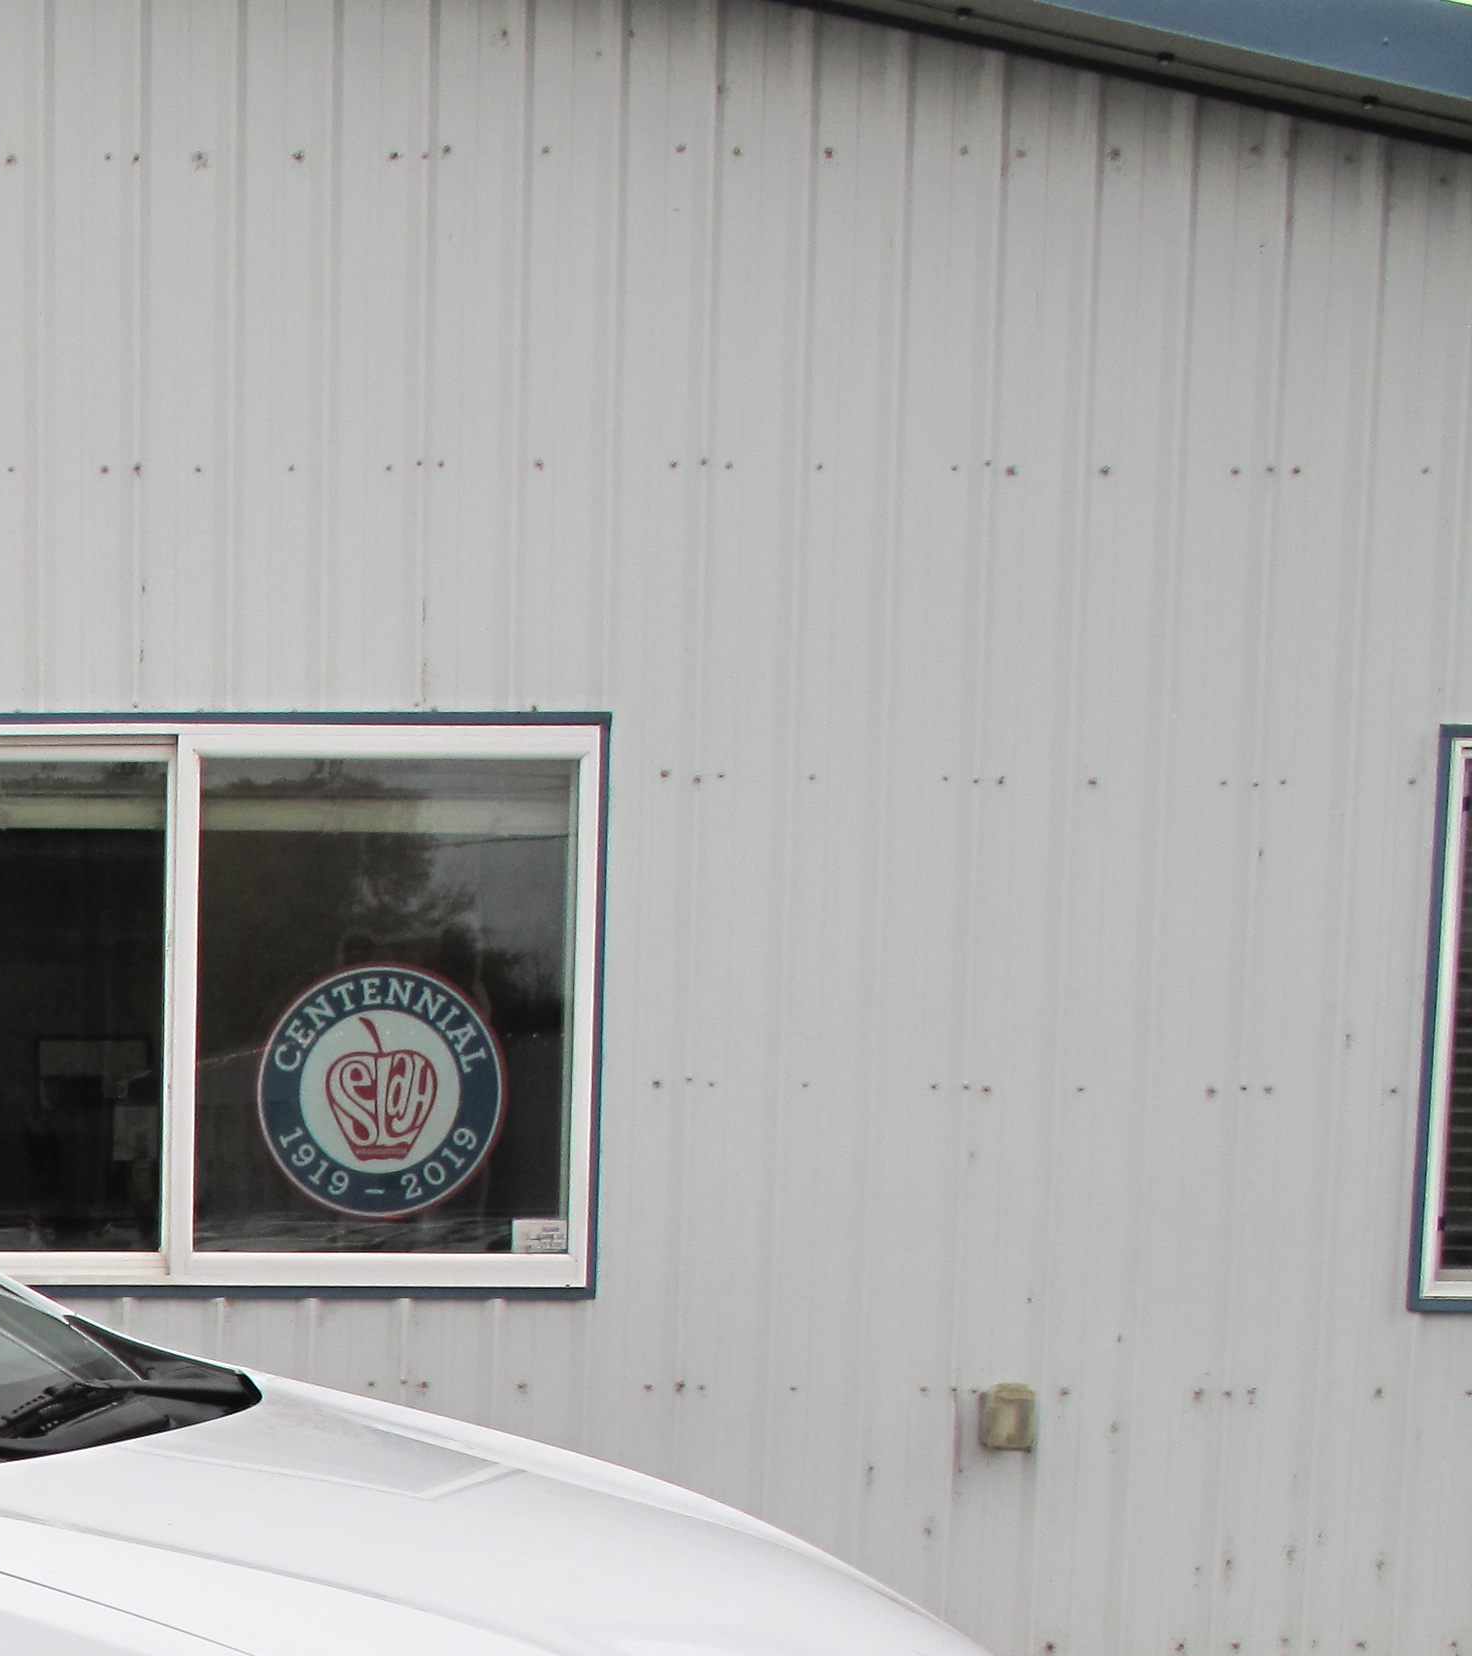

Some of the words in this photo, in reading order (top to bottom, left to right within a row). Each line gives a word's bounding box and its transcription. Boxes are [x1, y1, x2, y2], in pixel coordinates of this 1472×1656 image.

[274, 978, 487, 1073] CENTENNIAL
[279, 1127, 350, 1195] 1919
[400, 1127, 477, 1199] 2019
